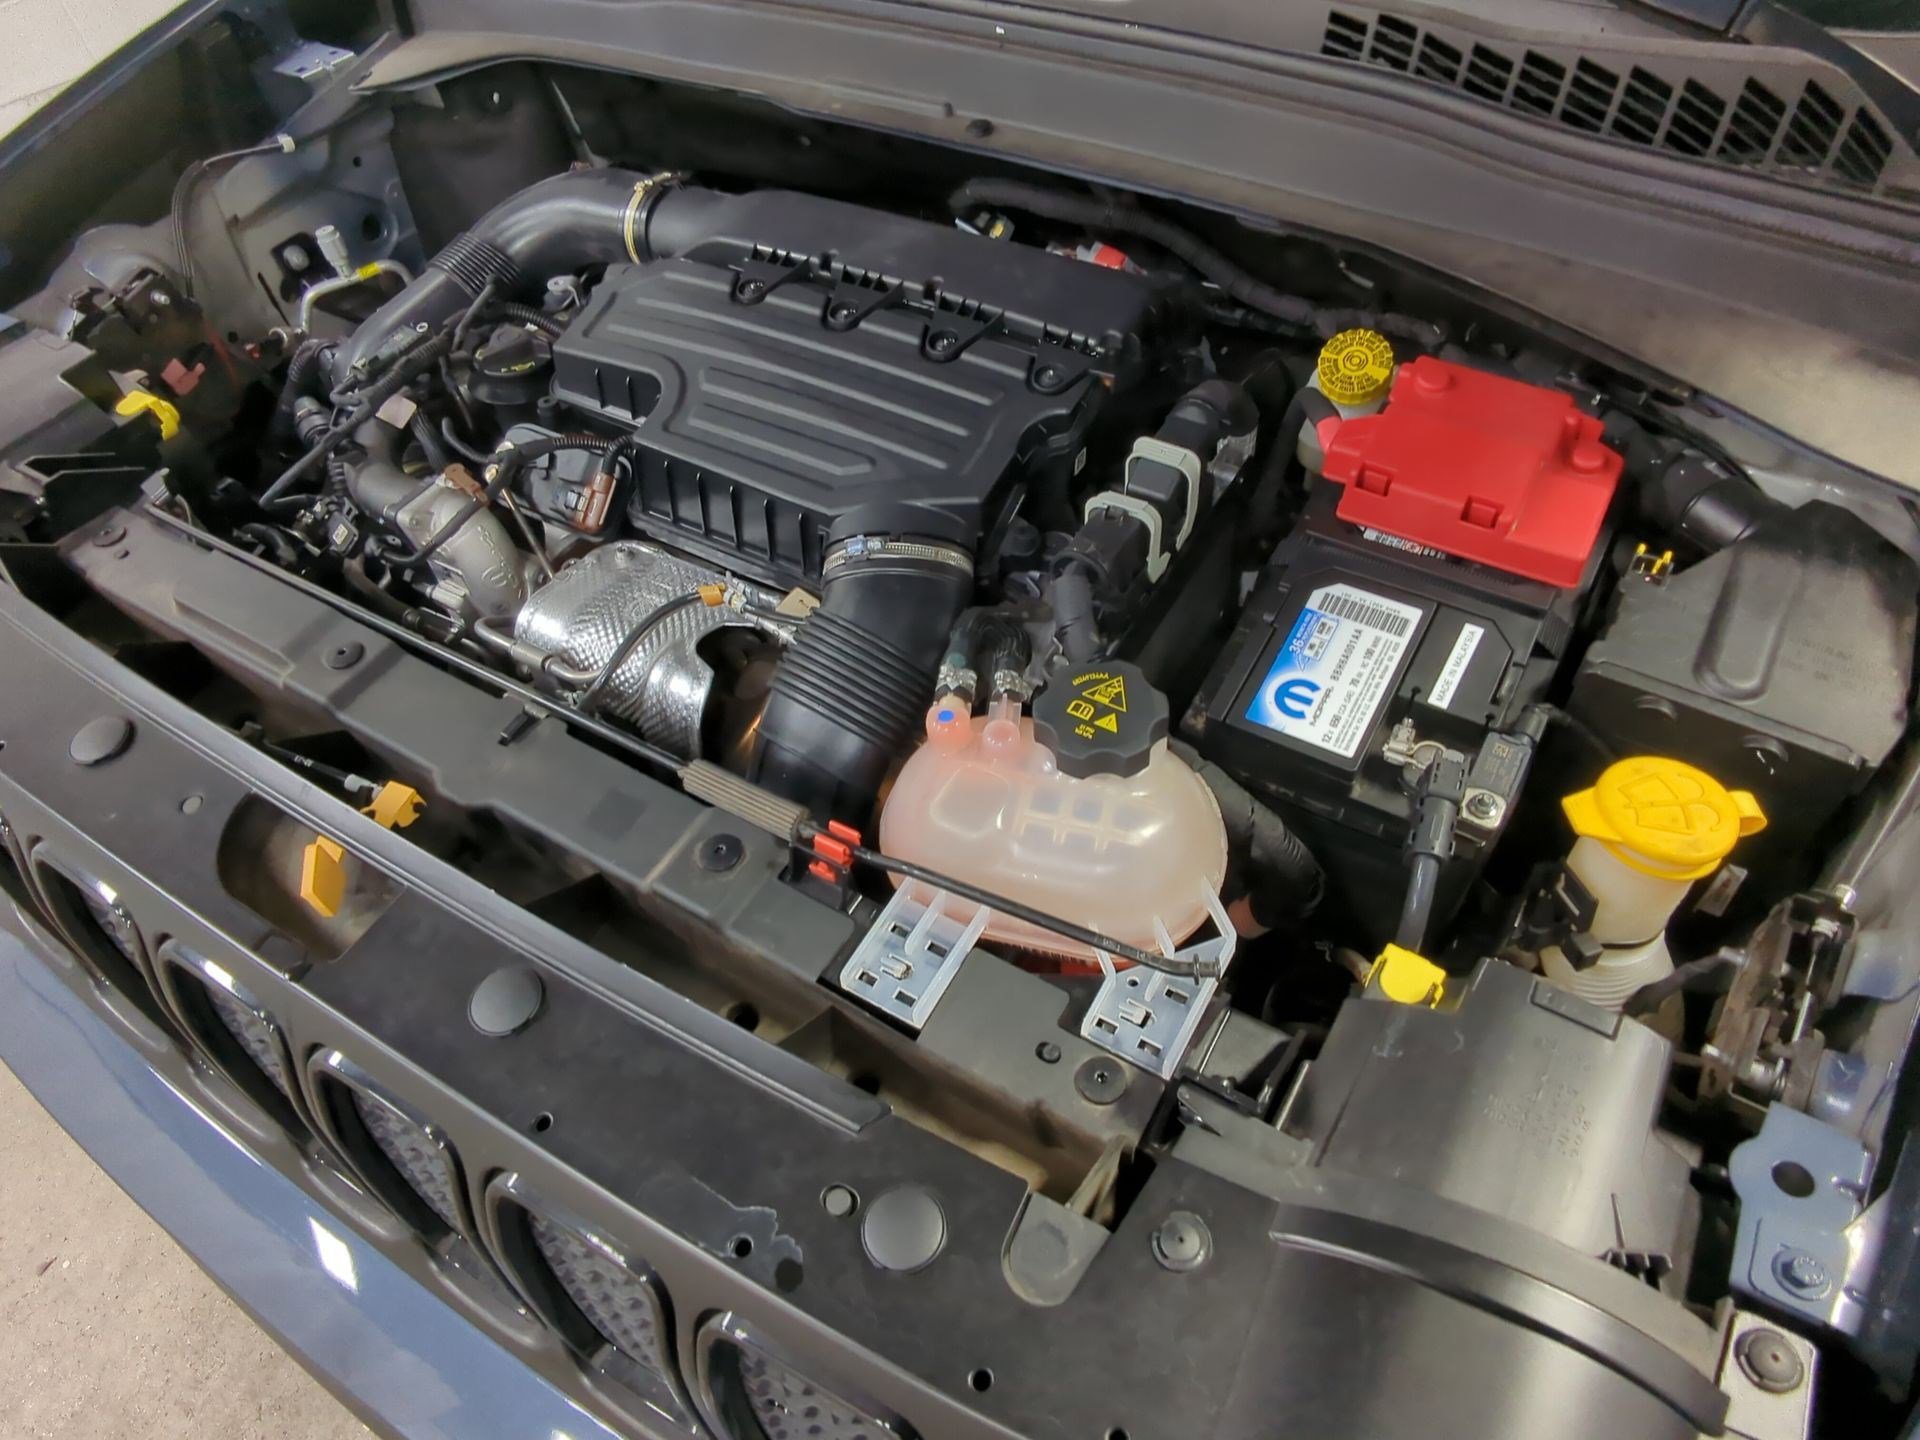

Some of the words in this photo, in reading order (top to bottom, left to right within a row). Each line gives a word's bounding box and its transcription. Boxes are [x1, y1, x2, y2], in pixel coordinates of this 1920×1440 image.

[1289, 638, 1304, 654] 36
[1434, 677, 1453, 702] MADE
[1446, 667, 1457, 678] IN
